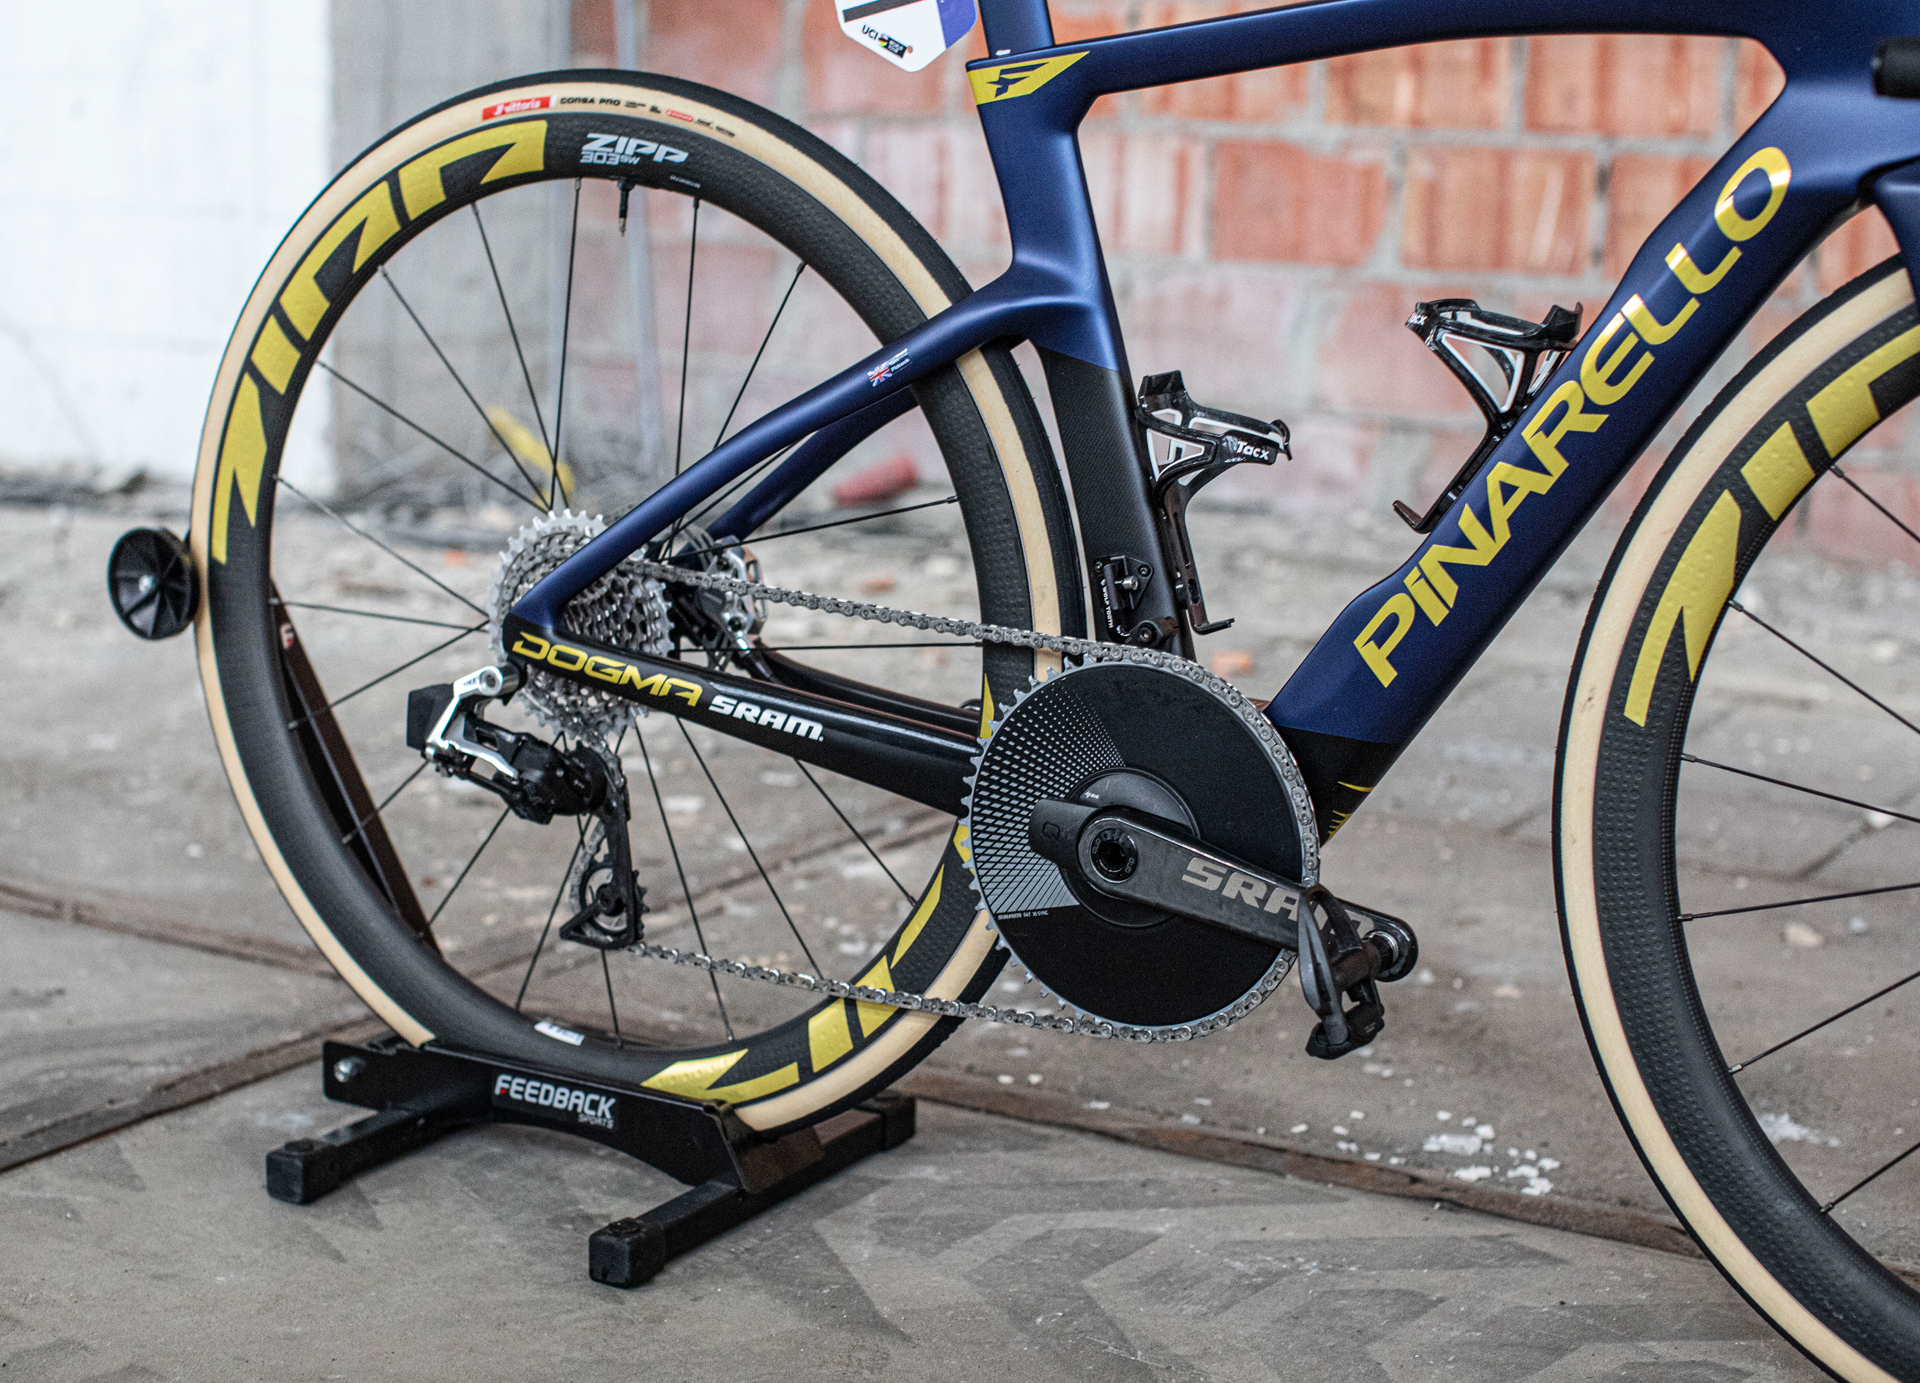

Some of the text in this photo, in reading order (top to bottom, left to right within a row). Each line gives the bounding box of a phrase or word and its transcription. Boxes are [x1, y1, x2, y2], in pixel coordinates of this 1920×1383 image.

[862, 24, 879, 40] UCI
[581, 132, 689, 163] ZIPP
[1353, 146, 1792, 688] PINARELLO
[1236, 440, 1270, 460] Tacx
[512, 631, 703, 707] DOGMA
[494, 1074, 616, 1119] FEEDBACK
[578, 1113, 615, 1129] SPORTS
